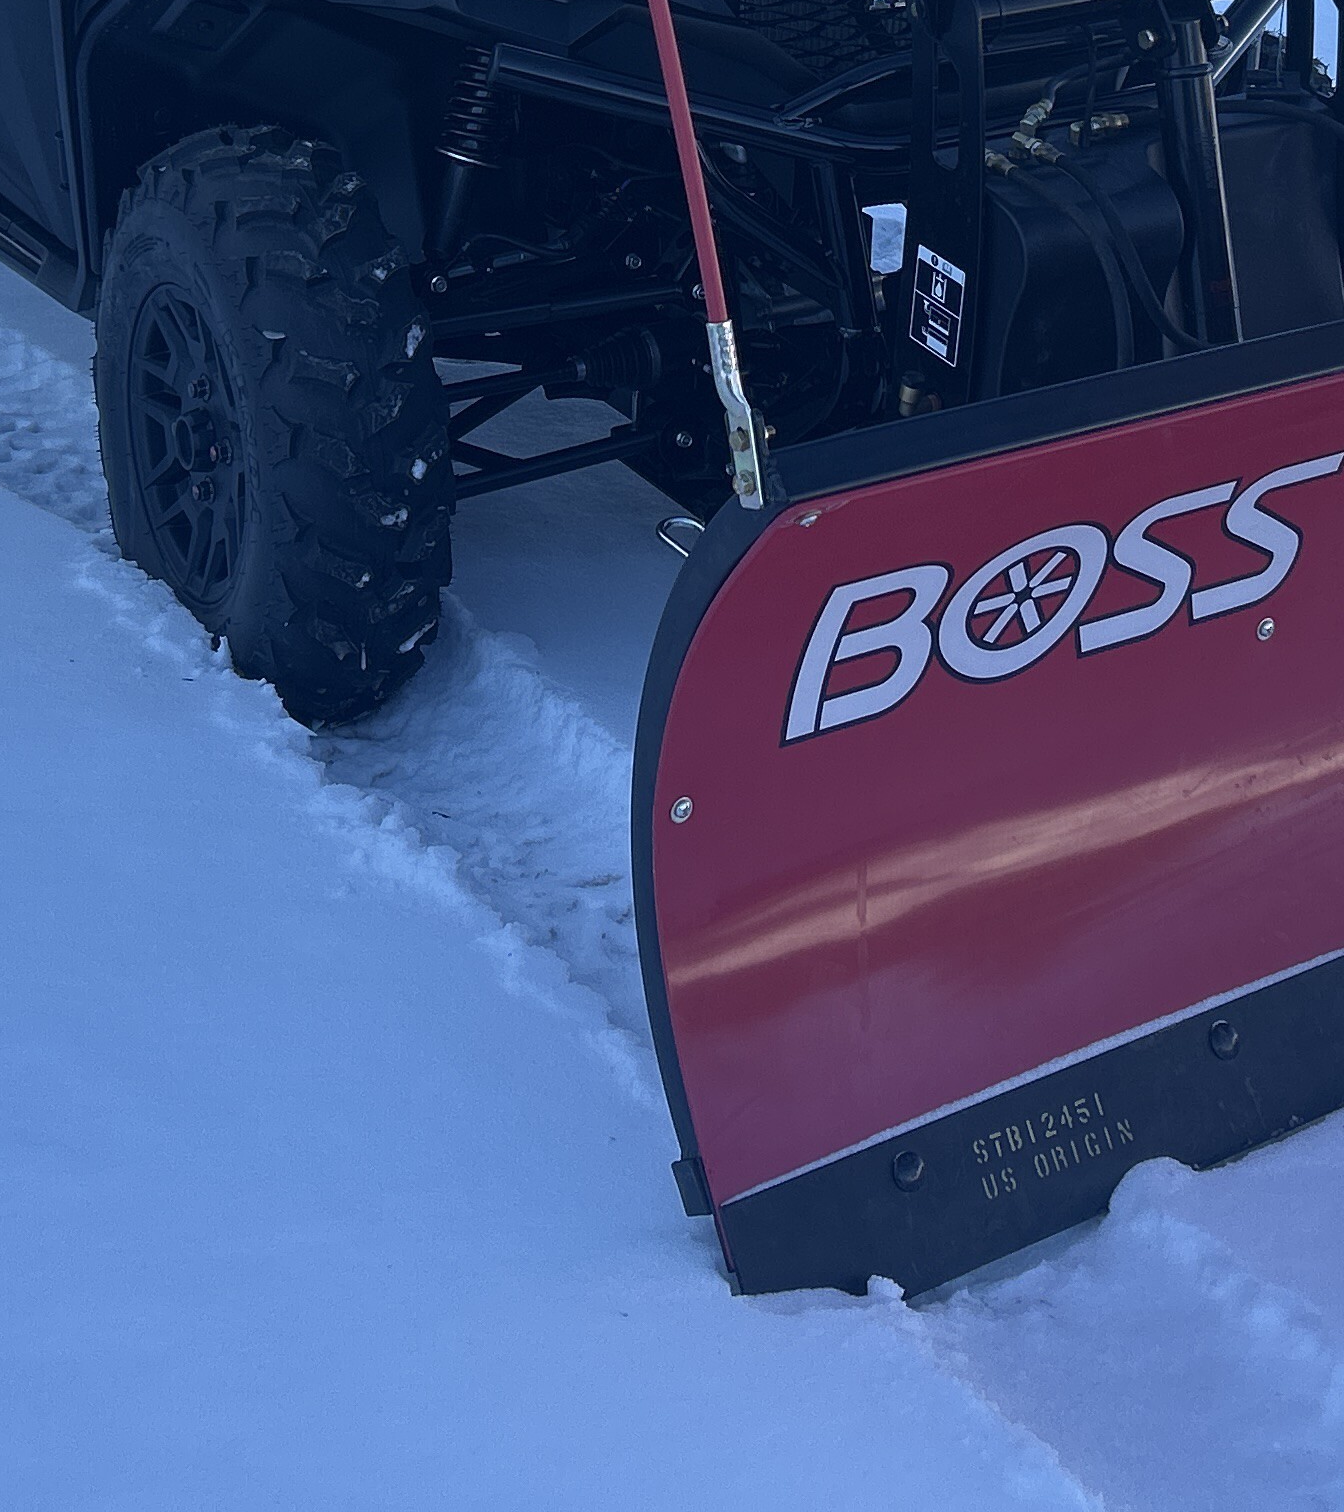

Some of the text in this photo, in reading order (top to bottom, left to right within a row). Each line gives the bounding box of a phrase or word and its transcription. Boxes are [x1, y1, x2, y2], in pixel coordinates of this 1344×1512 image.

[973, 1092, 1104, 1164] STB12451
[982, 1118, 1134, 1200] US ORIGIN
